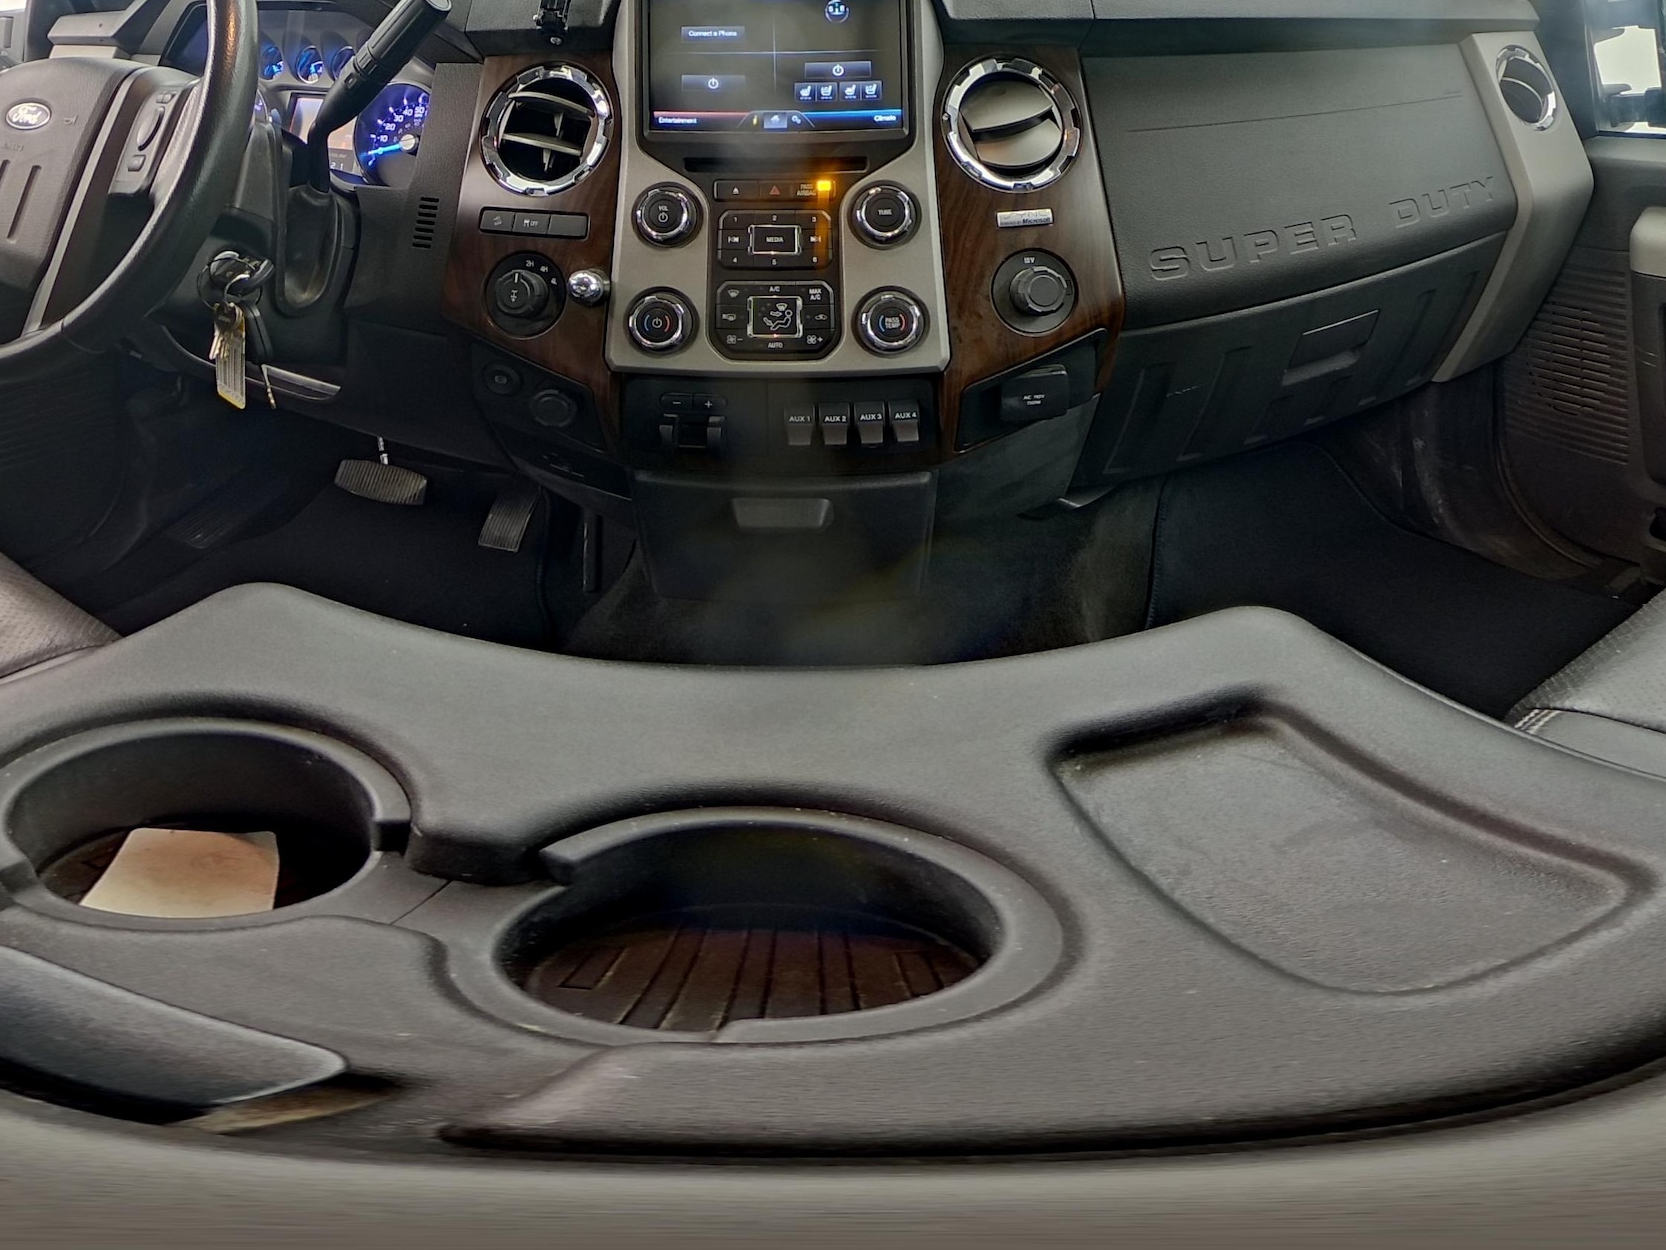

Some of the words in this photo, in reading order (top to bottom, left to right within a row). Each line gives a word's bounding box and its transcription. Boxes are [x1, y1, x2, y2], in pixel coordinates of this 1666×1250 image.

[402, 108, 413, 116] 40
[393, 114, 404, 122] 30
[658, 117, 697, 125] Entertainment
[874, 114, 897, 122] Climate
[385, 123, 396, 131] 20
[1148, 213, 1358, 281] SUPER
[1388, 175, 1495, 230] DUTY
[525, 259, 535, 267] 2H
[539, 265, 549, 273] 4H
[769, 285, 781, 293] A/C
[788, 415, 805, 423] AUX
[824, 415, 840, 423] AUX
[860, 413, 876, 422] AUX
[894, 412, 910, 420] AUX
